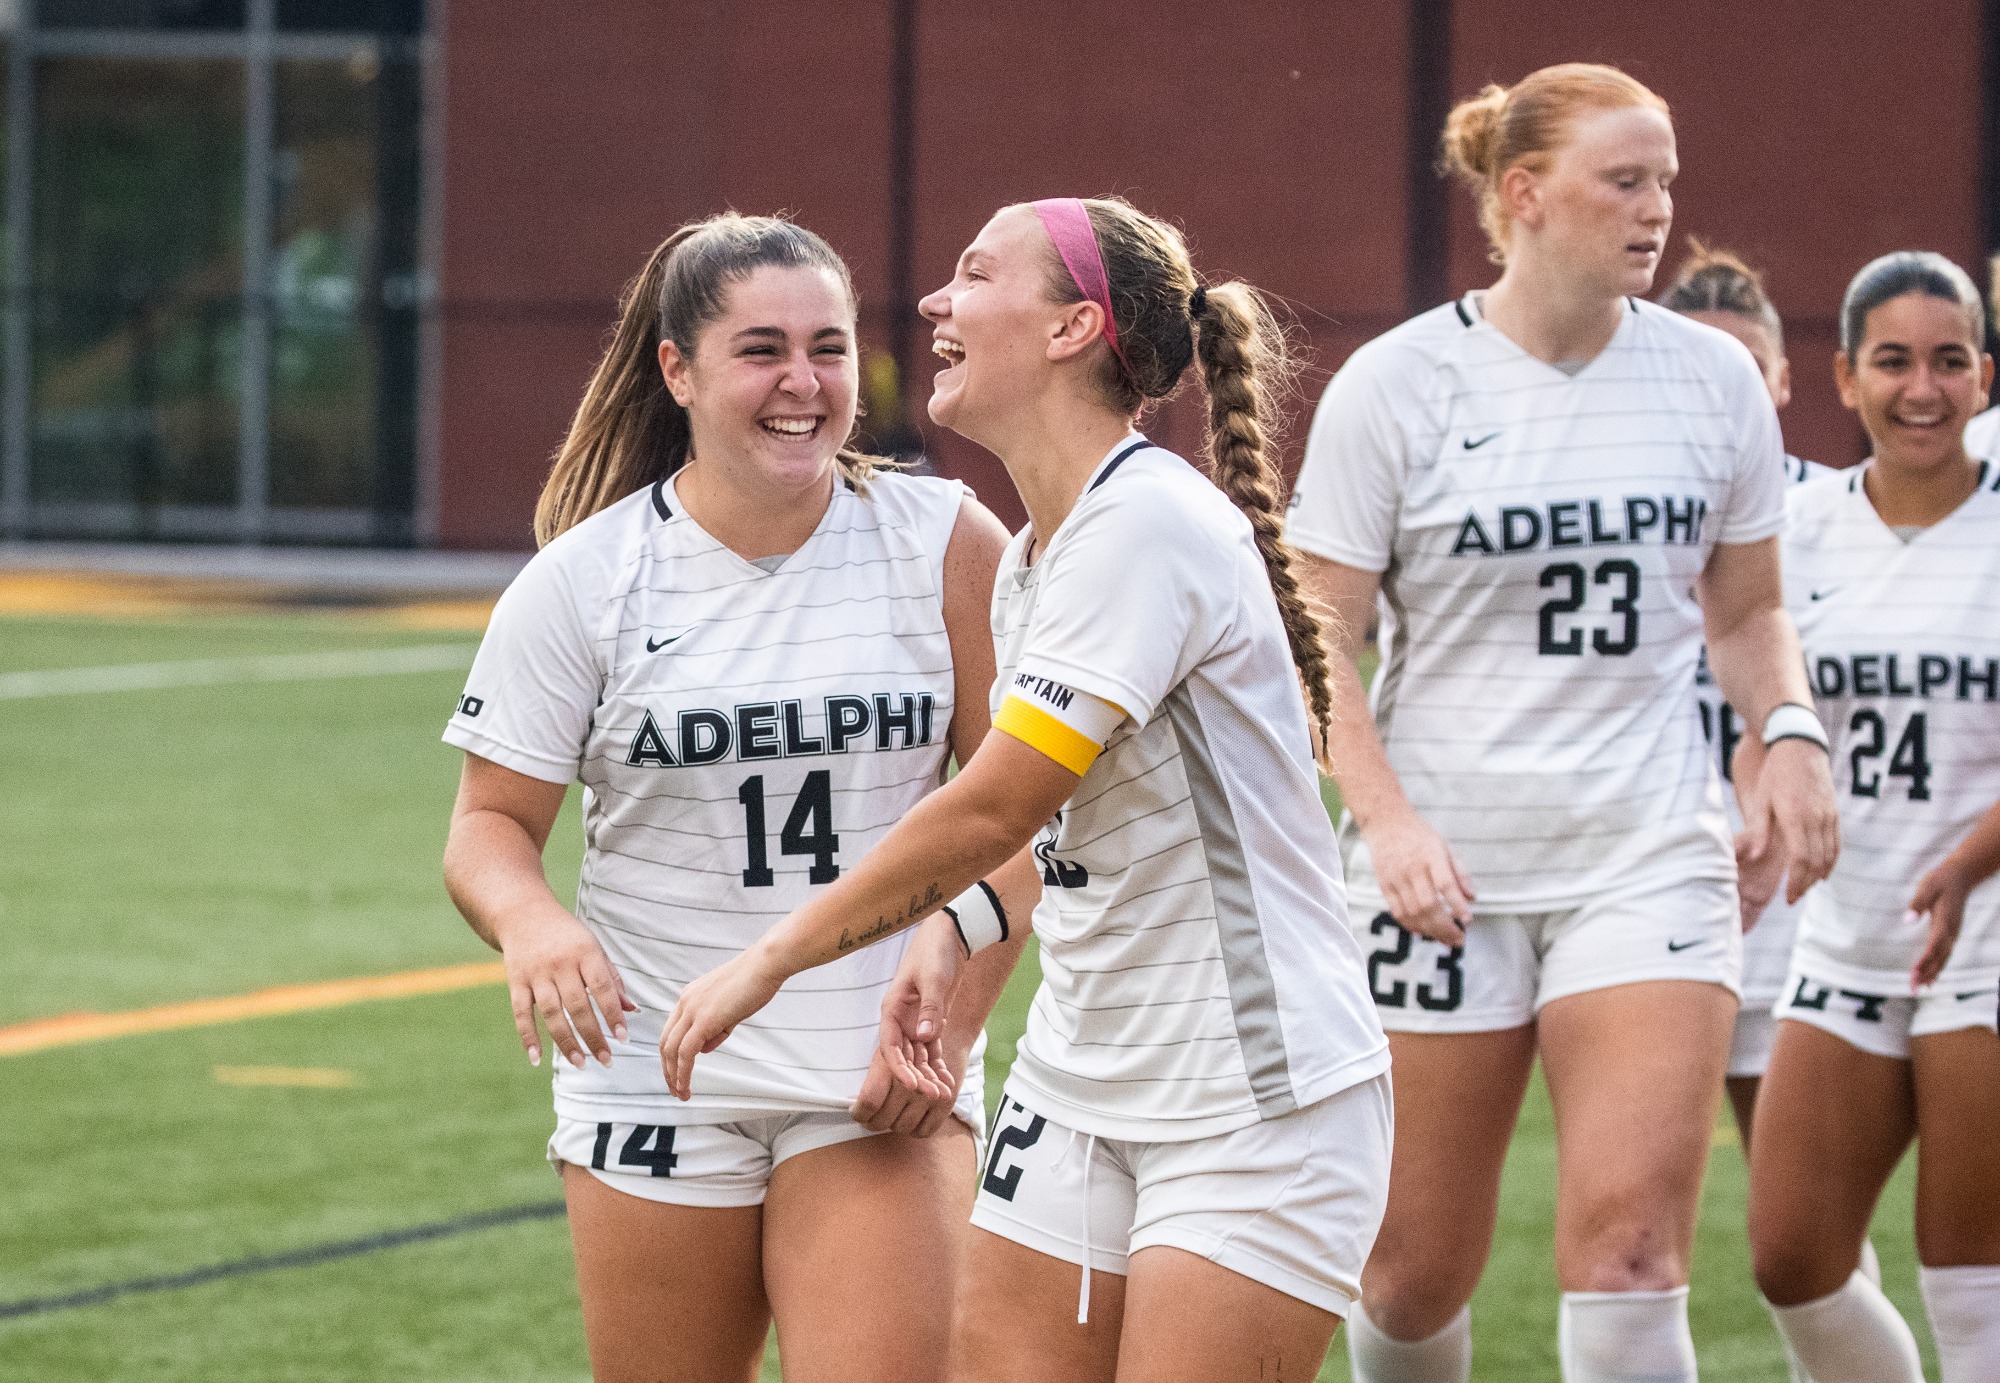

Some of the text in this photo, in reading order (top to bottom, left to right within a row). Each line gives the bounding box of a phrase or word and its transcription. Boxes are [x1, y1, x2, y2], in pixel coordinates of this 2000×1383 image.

[1538, 558, 1641, 656] 23
[1804, 653, 2000, 702] DELPH
[626, 692, 935, 768] ADELPHI
[1850, 709, 1931, 801] 24
[738, 770, 840, 887] 14
[1368, 911, 1464, 1012] 23
[591, 1122, 679, 1177] 14
[982, 1093, 1047, 1202] 2
